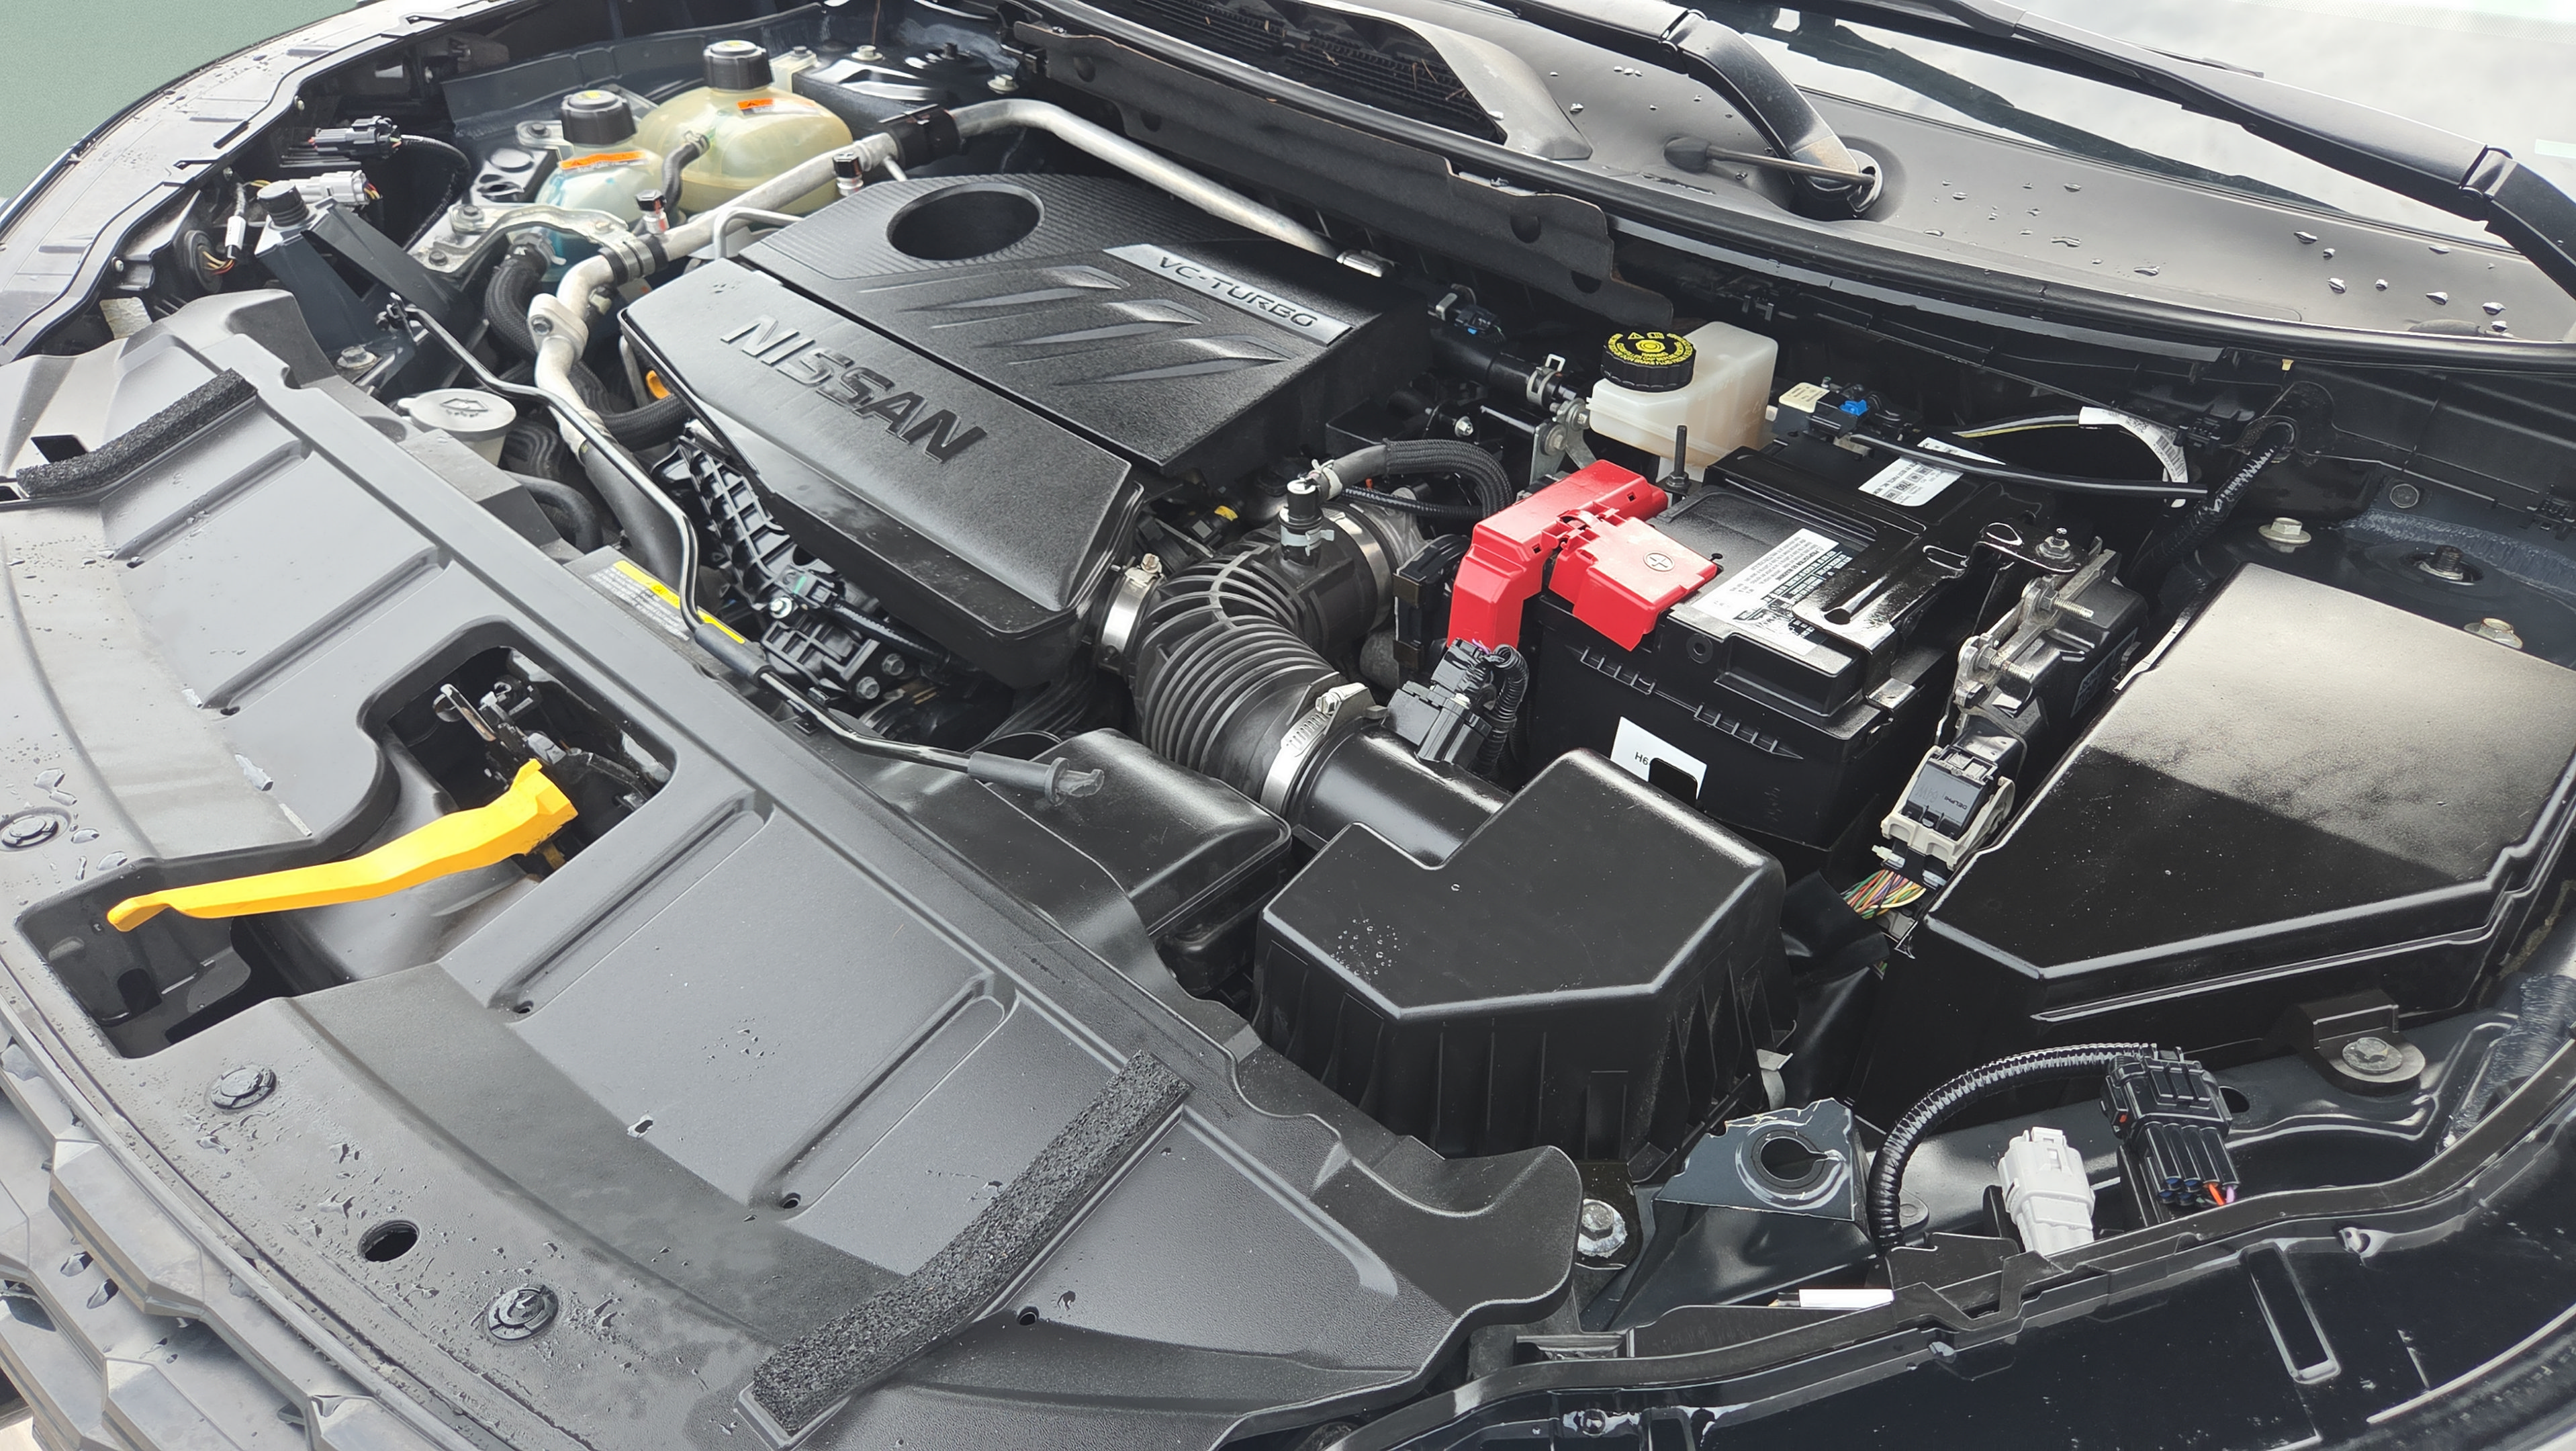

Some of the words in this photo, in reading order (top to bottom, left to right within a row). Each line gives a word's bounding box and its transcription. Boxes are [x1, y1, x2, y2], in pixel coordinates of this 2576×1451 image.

[1160, 257, 1318, 327] VC-TURBO
[721, 314, 987, 463] NISSAN
[1895, 481, 1911, 491] 760
[1635, 752, 1649, 765] H6
[1944, 795, 1967, 810] DELPHI
